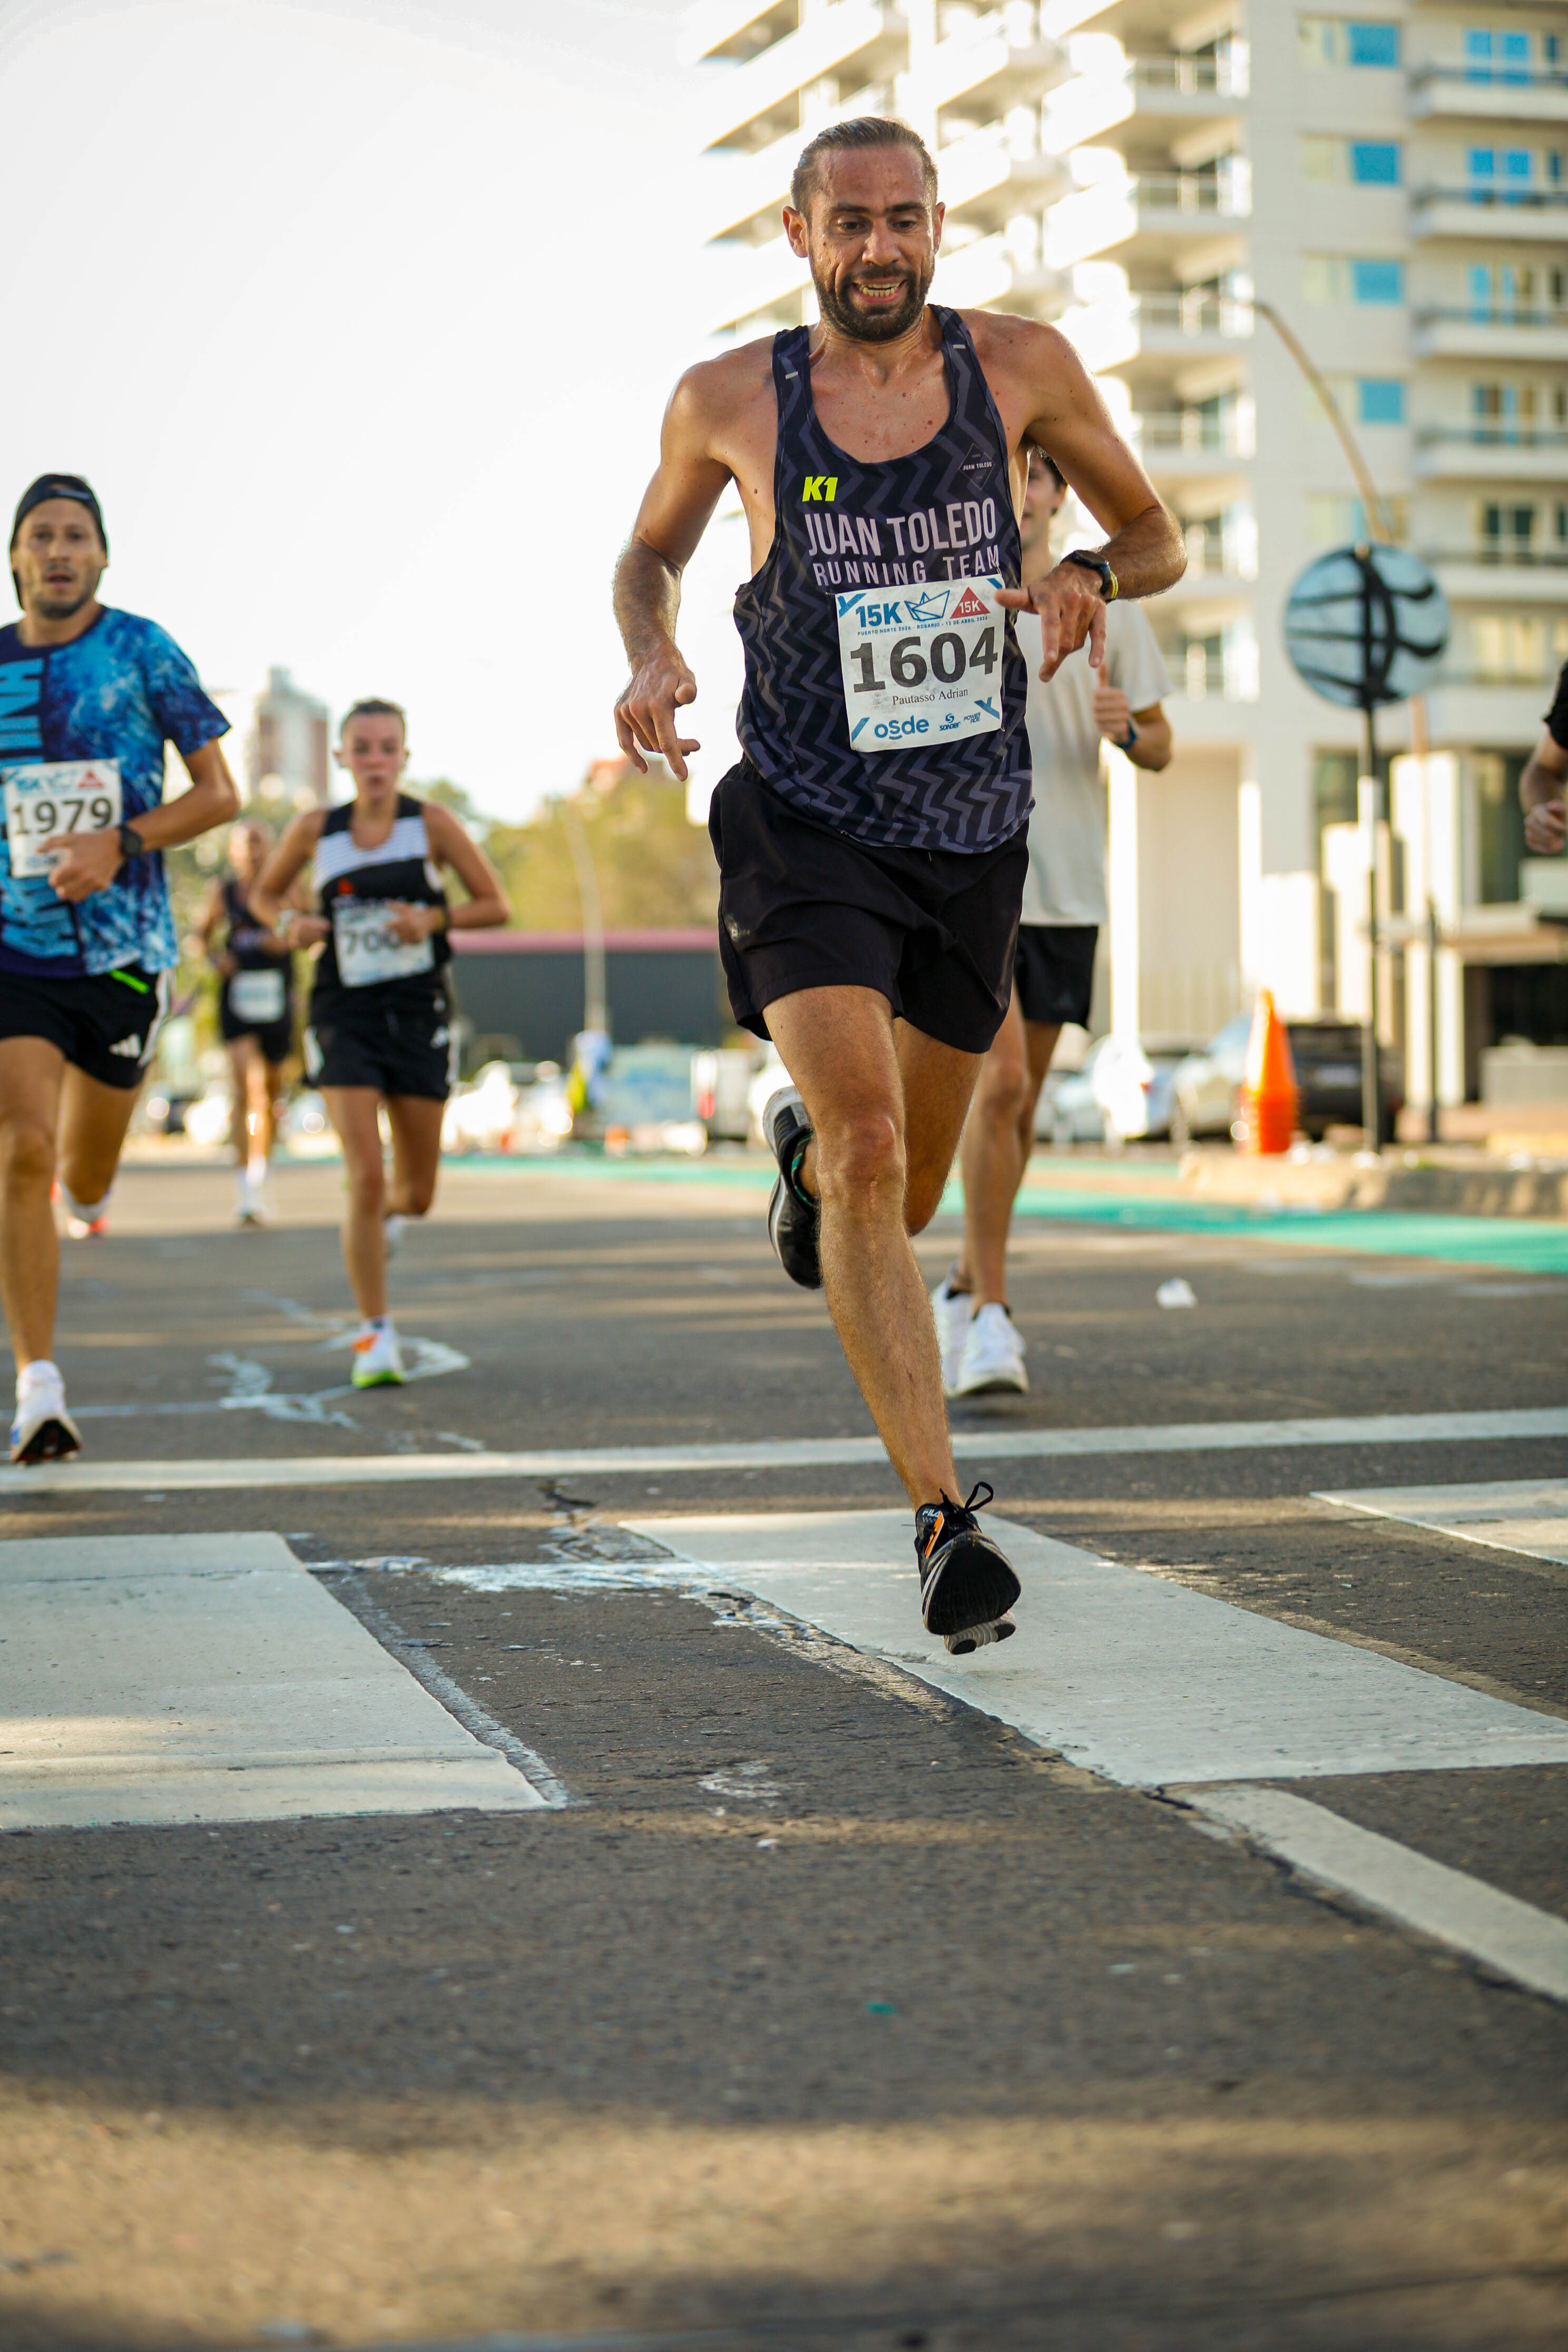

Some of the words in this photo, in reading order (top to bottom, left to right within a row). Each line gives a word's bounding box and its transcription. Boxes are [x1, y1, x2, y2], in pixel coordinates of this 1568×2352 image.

[802, 476, 838, 502] K1
[805, 513, 881, 556] JUAN
[886, 497, 996, 556] TOLEDO
[813, 560, 926, 586] RUNNING
[943, 545, 1000, 581] TEAM
[856, 602, 903, 628] 15K
[959, 600, 981, 614] 15K
[850, 626, 998, 693] 1604
[892, 694, 935, 705] Pautasso
[938, 688, 968, 701] Adrian
[874, 715, 929, 739] osde
[12, 797, 113, 835] 1979
